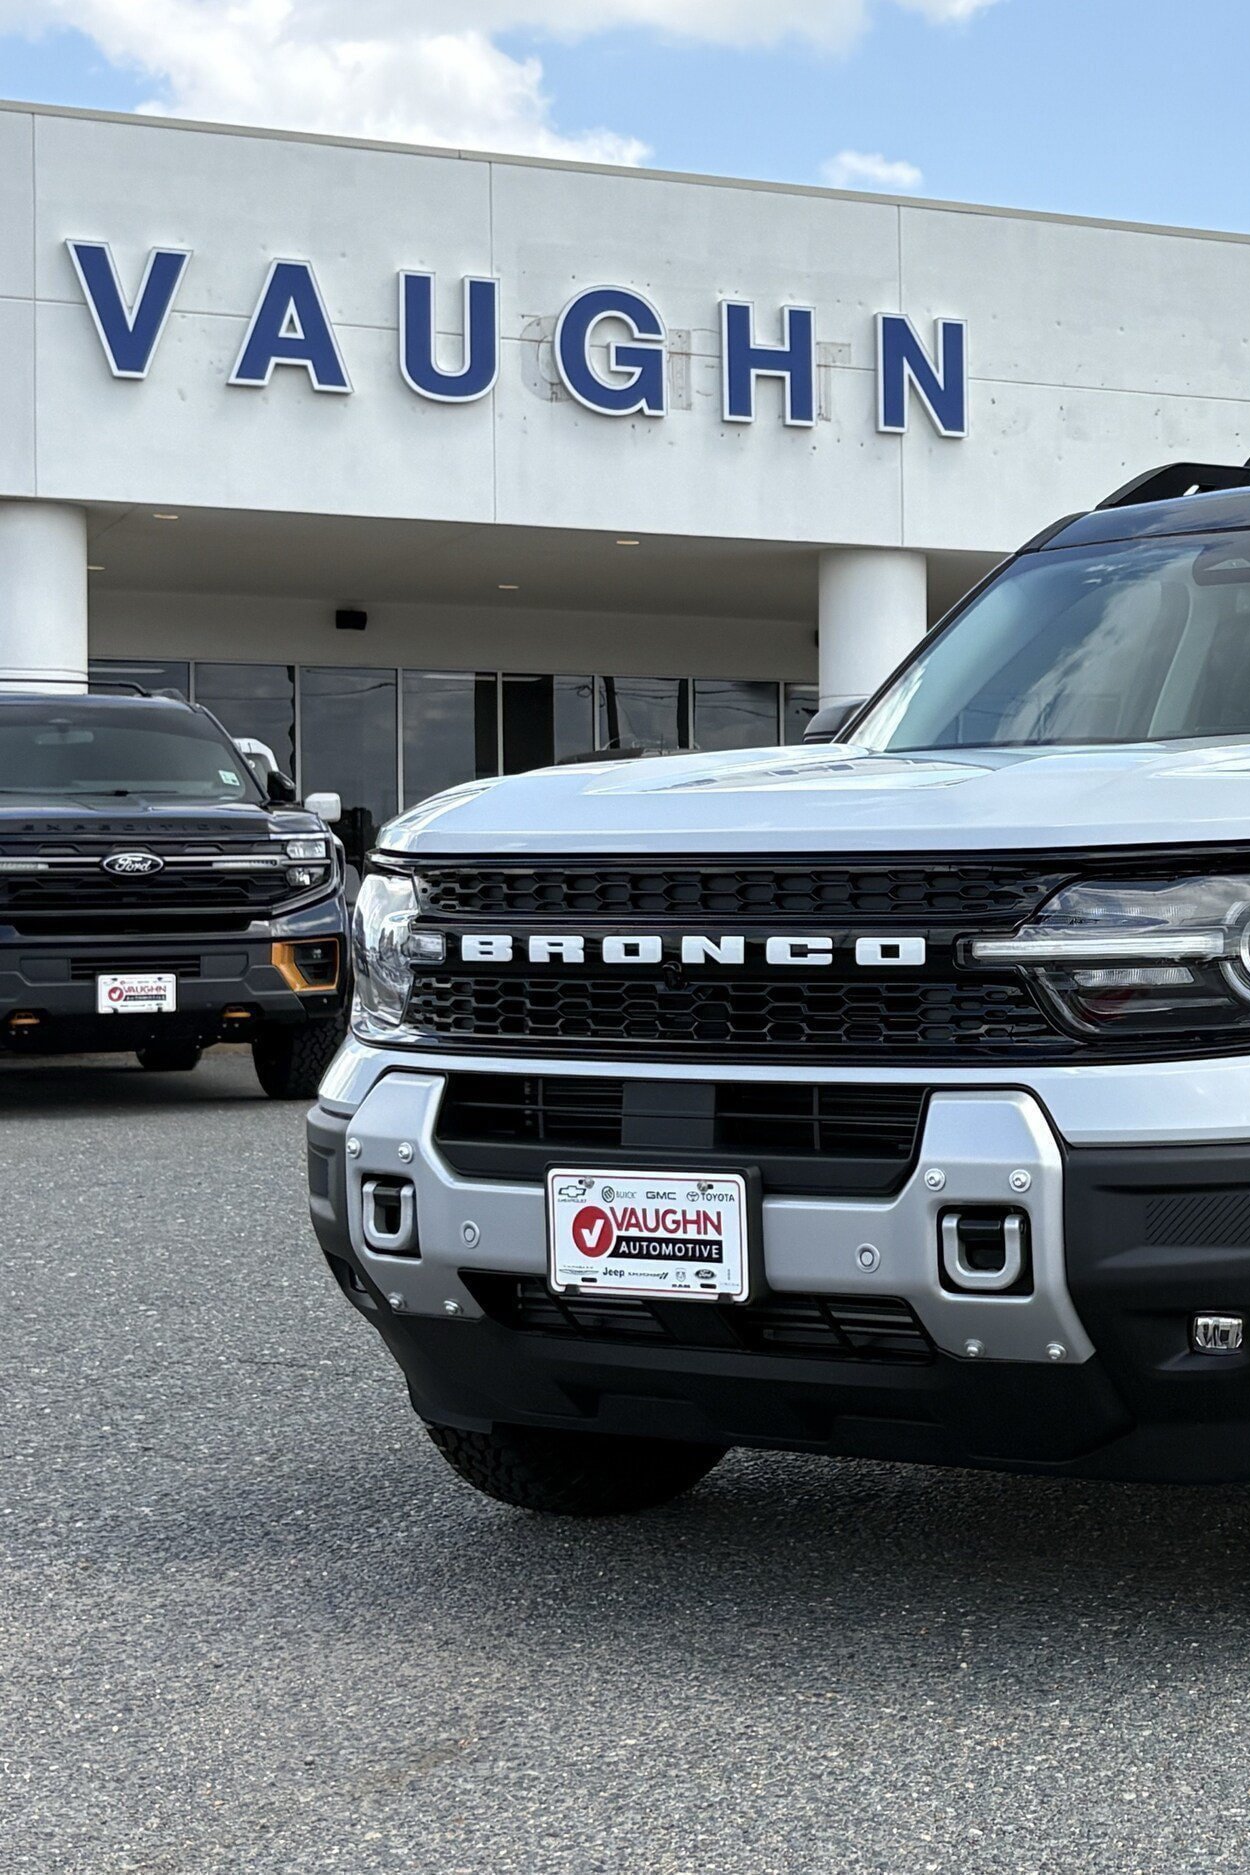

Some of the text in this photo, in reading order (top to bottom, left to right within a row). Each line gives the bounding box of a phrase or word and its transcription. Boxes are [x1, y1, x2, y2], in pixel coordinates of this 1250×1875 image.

[64, 238, 969, 439] VAUGHN
[114, 856, 152, 872] Ford
[460, 934, 926, 966] BRONCO
[645, 1191, 677, 1200] GMC
[701, 1192, 735, 1202] TOYOTA
[609, 1206, 723, 1236] VAUGHN
[619, 1241, 720, 1259] AUTOMOTIVE
[602, 1267, 625, 1278] Jeep
